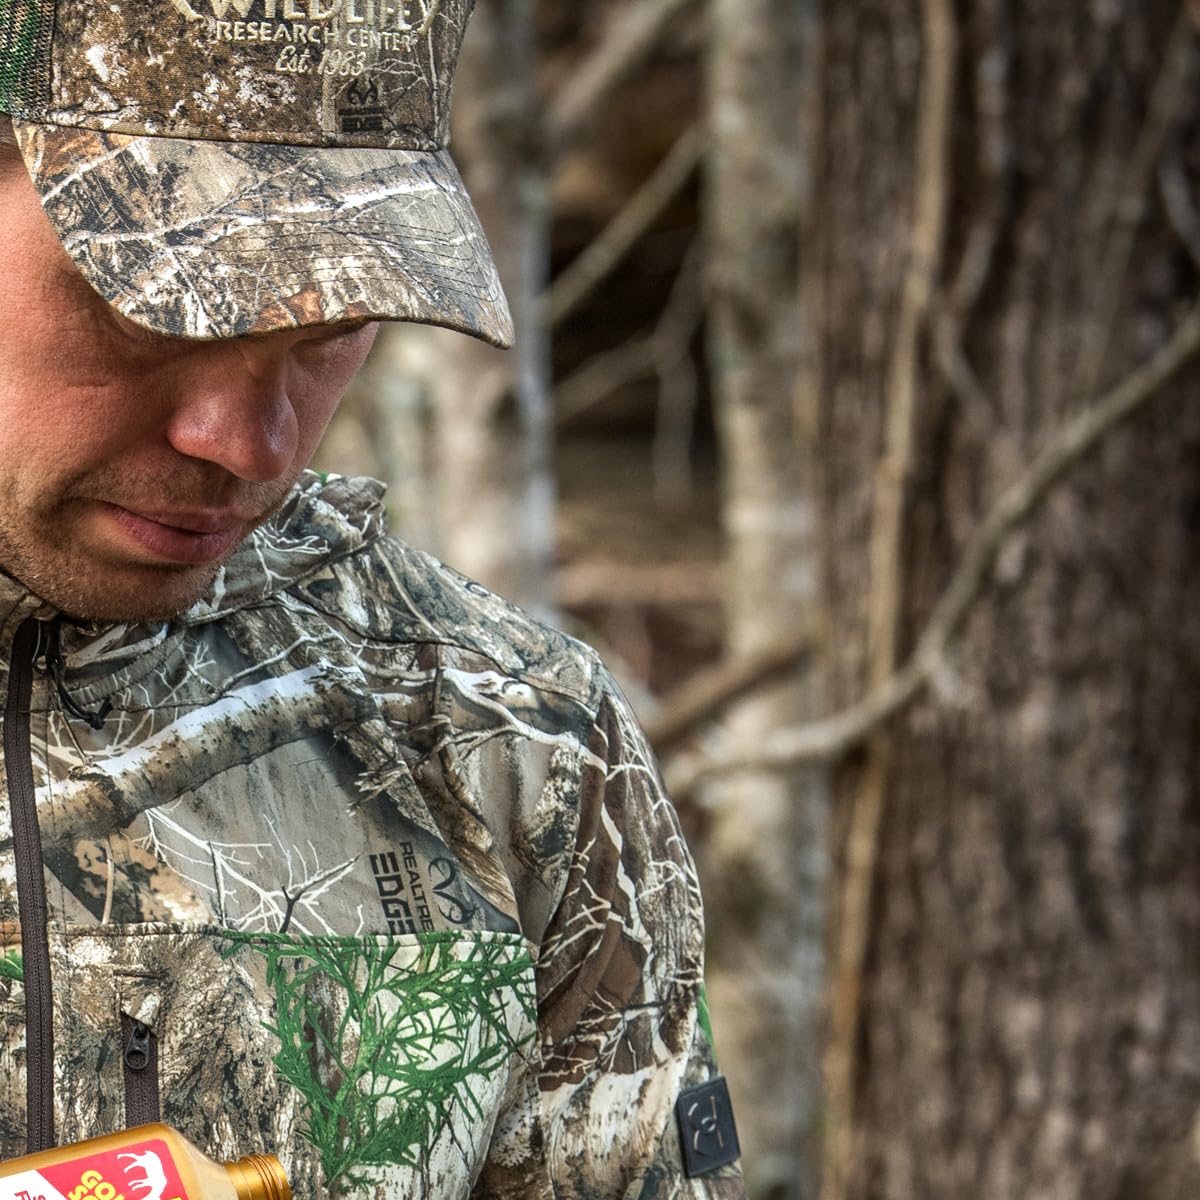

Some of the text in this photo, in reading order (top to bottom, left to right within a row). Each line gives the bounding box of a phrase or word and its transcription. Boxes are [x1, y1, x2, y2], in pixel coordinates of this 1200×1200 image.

[216, 21, 411, 52] RESEARCH CENTER
[275, 45, 364, 76] Est. 1983
[369, 852, 417, 935] EDGE
